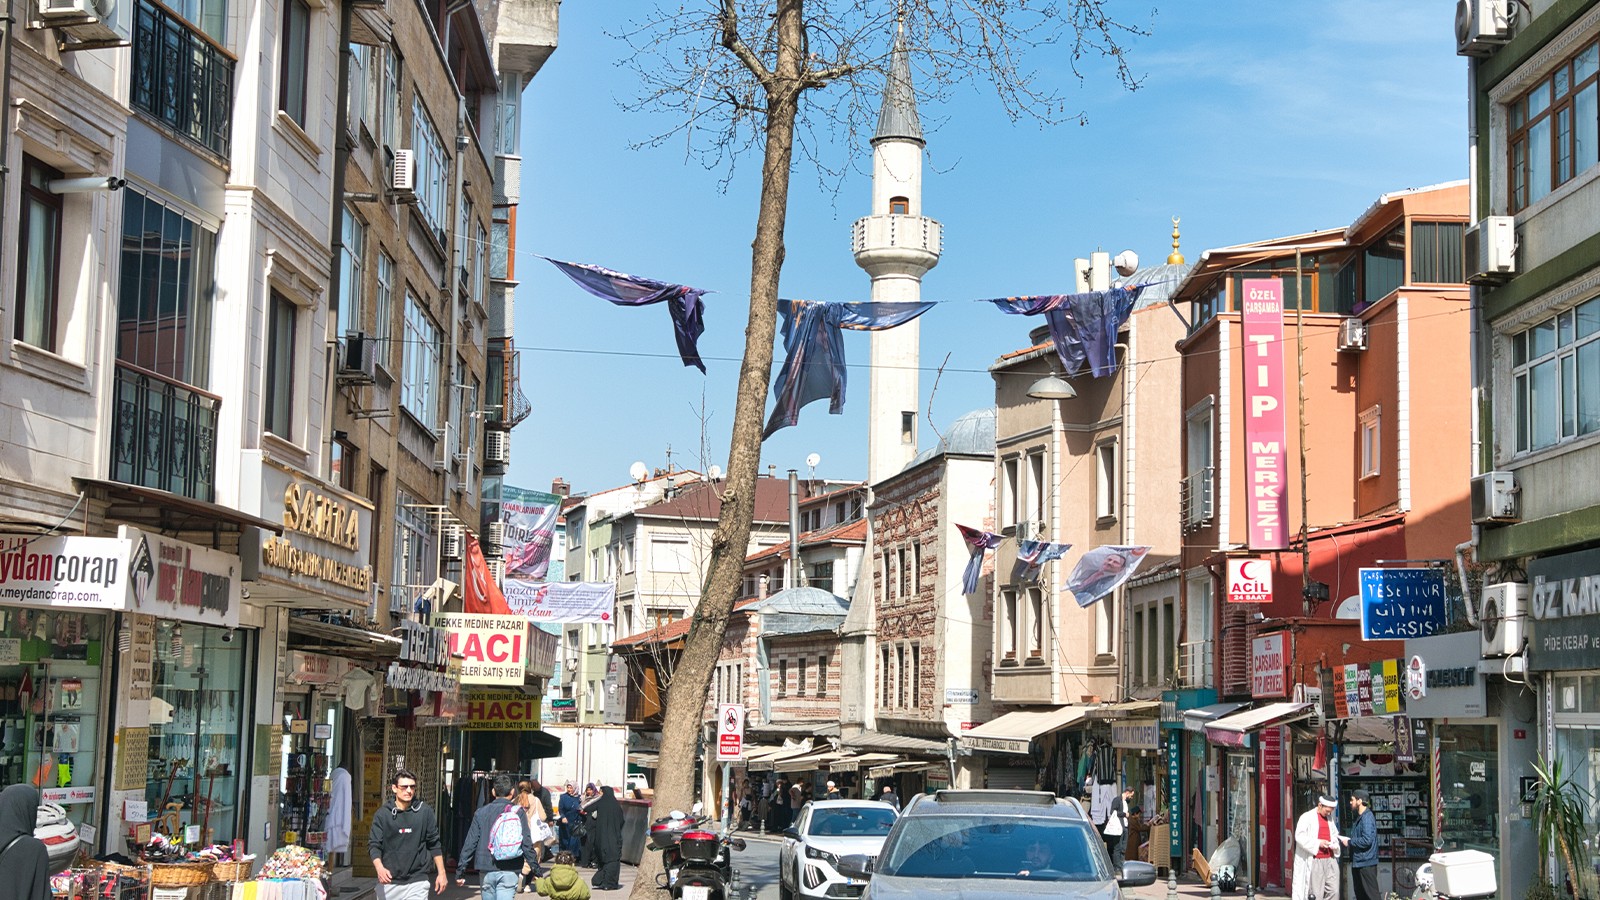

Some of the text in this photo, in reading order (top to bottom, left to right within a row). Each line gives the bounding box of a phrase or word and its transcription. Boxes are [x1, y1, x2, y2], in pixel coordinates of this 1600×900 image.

[1249, 287, 1276, 300] ÖZEL
[1245, 301, 1280, 315] ÇARŞAMBA
[1249, 335, 1278, 418] TIP
[1252, 441, 1280, 542] MERKEZİ
[1231, 580, 1269, 593] ACİL
[528, 605, 552, 617] olsun
[434, 617, 524, 630] MEKKE MEDİNE PAZARI
[1544, 634, 1561, 651] PİDE
[1562, 634, 1588, 650] KEBAP
[482, 666, 503, 680] SATIŞ
[505, 666, 522, 678] YERİ
[487, 692, 513, 701] MEDİNE
[468, 701, 532, 720] HACI
[505, 721, 523, 730] SATIŞ
[524, 720, 539, 729] YERİ
[1171, 778, 1179, 846] TESETTÜR
